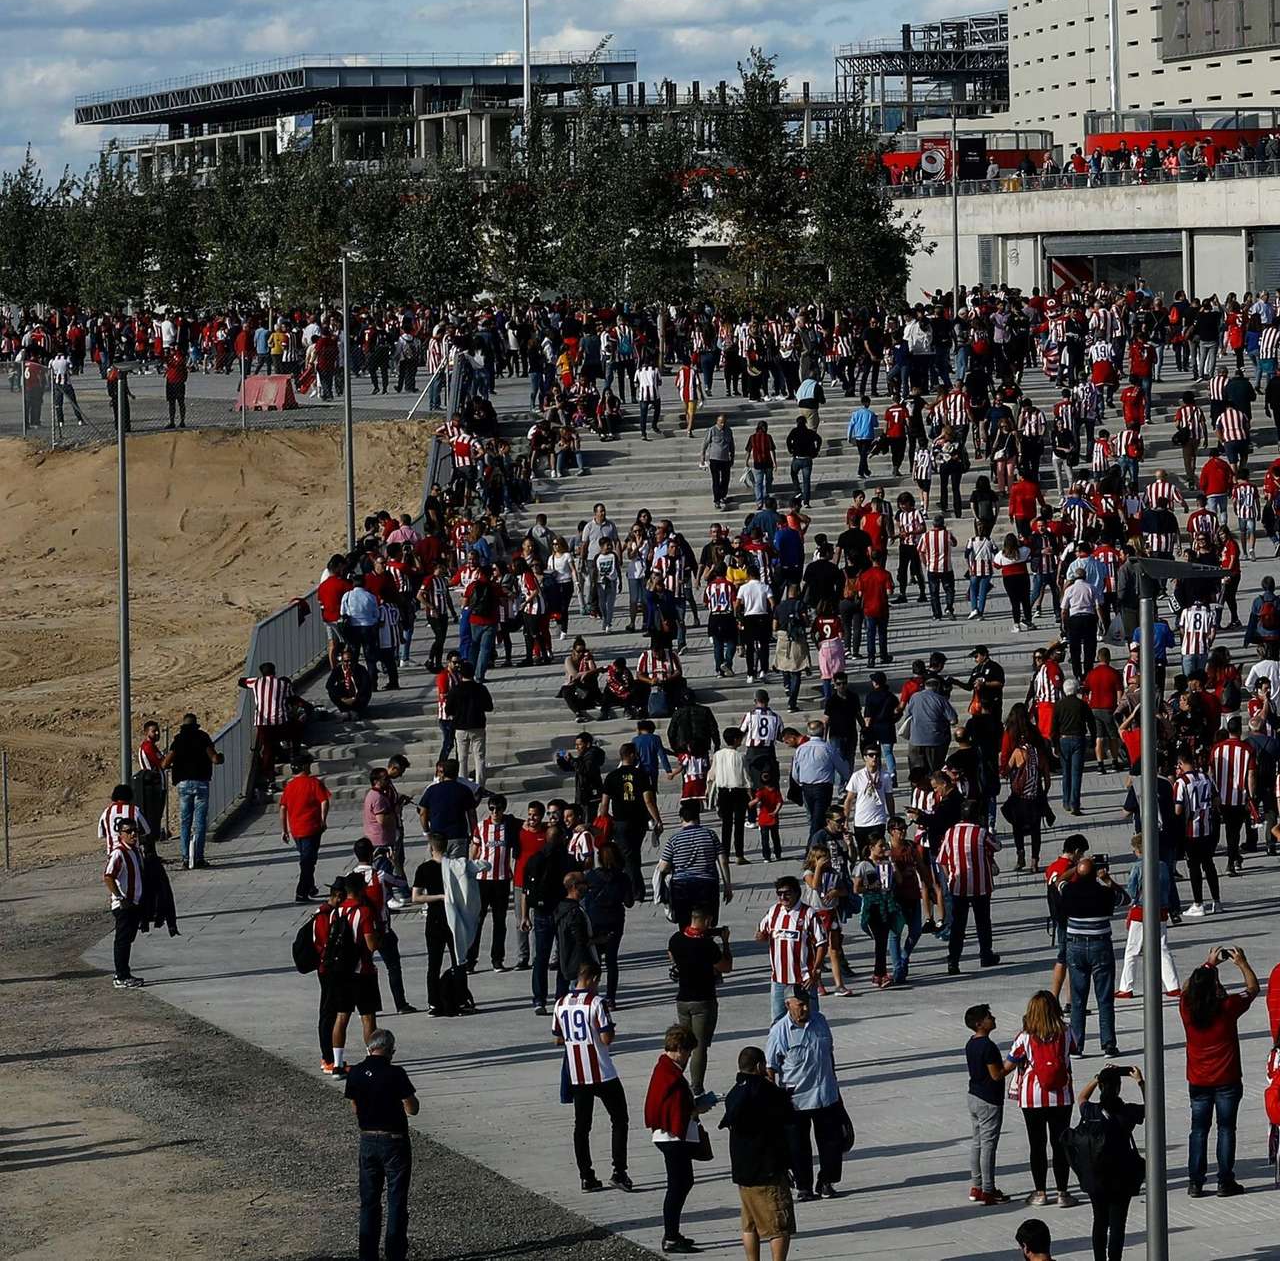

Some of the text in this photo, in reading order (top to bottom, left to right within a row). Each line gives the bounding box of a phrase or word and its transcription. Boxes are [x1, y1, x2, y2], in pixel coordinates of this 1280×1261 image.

[1194, 612, 1202, 630] 8
[759, 717, 768, 738] 8
[1192, 782, 1210, 808] 14
[561, 1009, 587, 1043] 19
